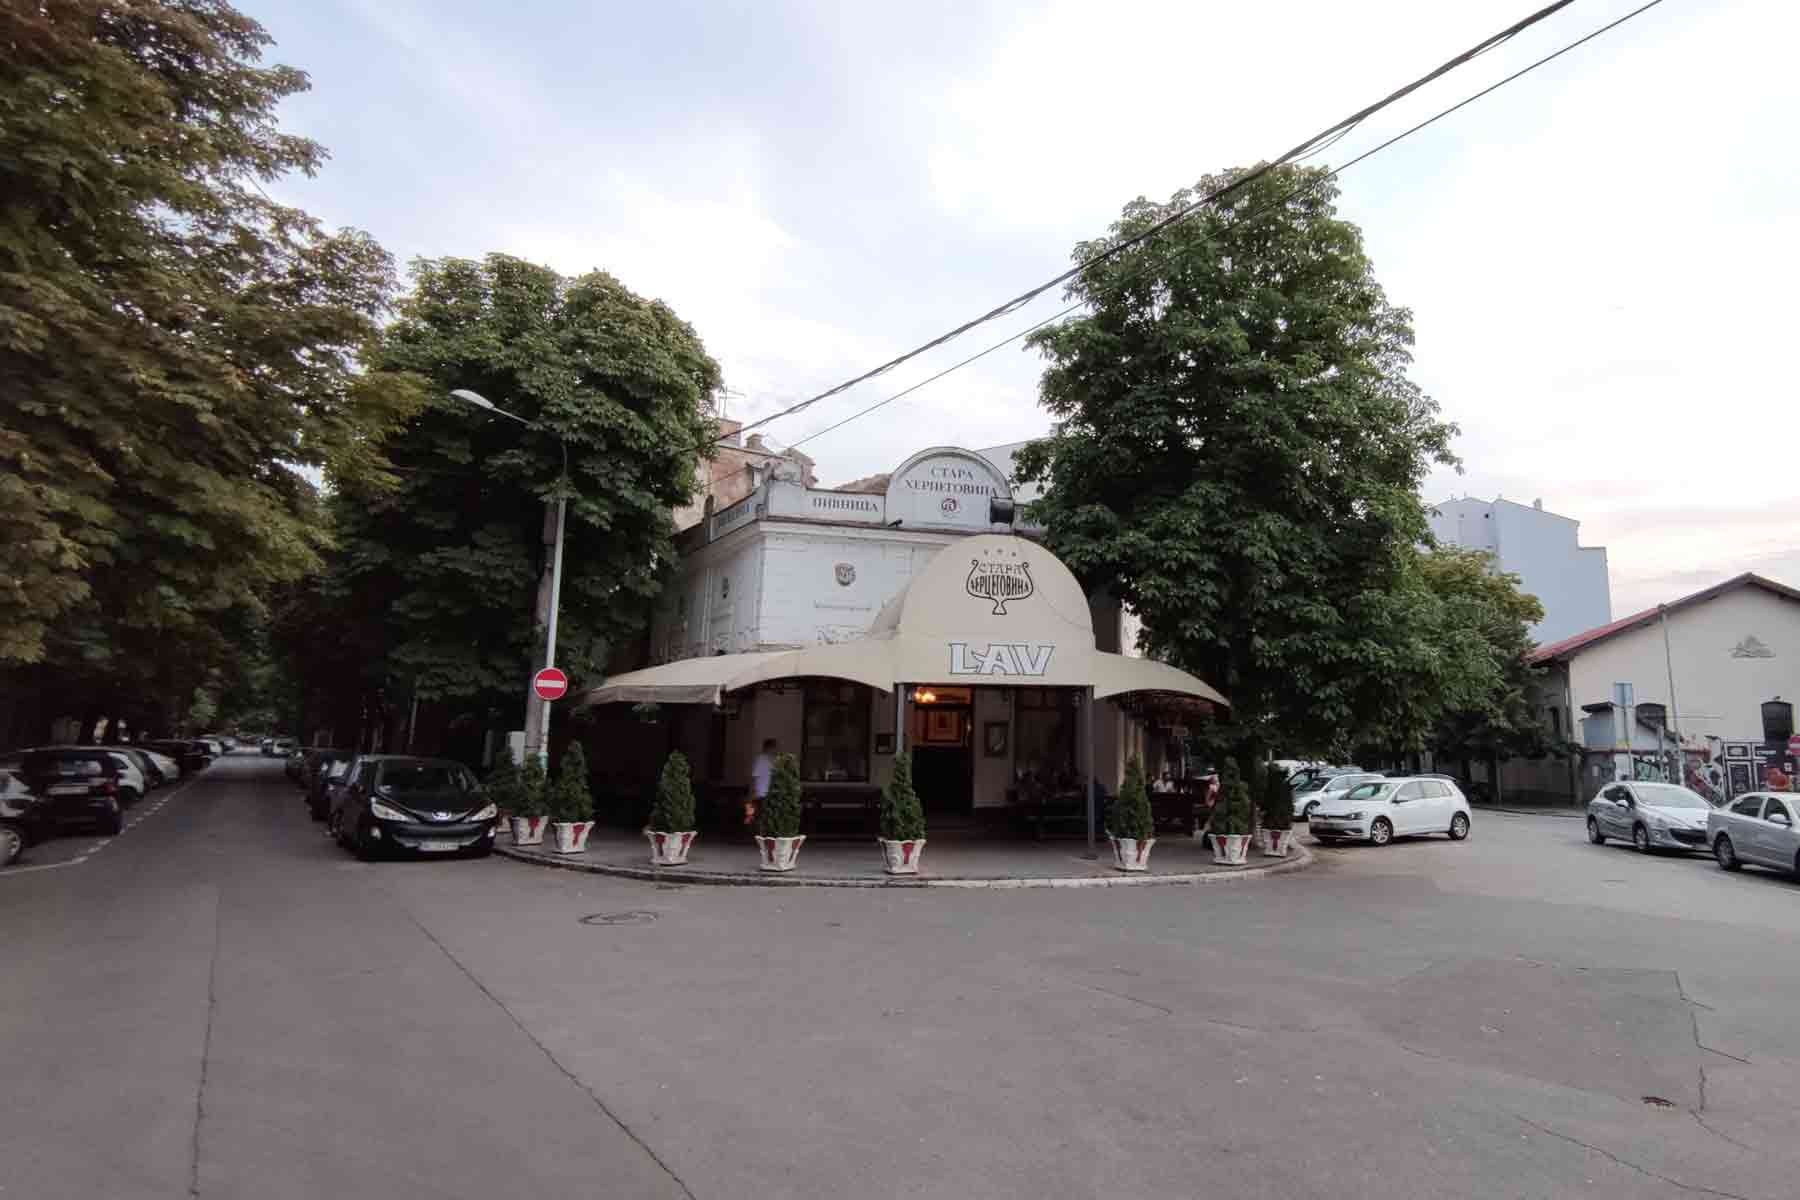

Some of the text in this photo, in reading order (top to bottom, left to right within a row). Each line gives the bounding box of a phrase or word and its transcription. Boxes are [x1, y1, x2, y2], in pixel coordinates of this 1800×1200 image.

[931, 467, 974, 480] СТАРА
[905, 479, 998, 497] ХЕРЦЕГОВИНА
[812, 497, 879, 512] ПИВНИЦА
[978, 562, 1022, 575] СТАРА
[948, 642, 1056, 676] LAV
